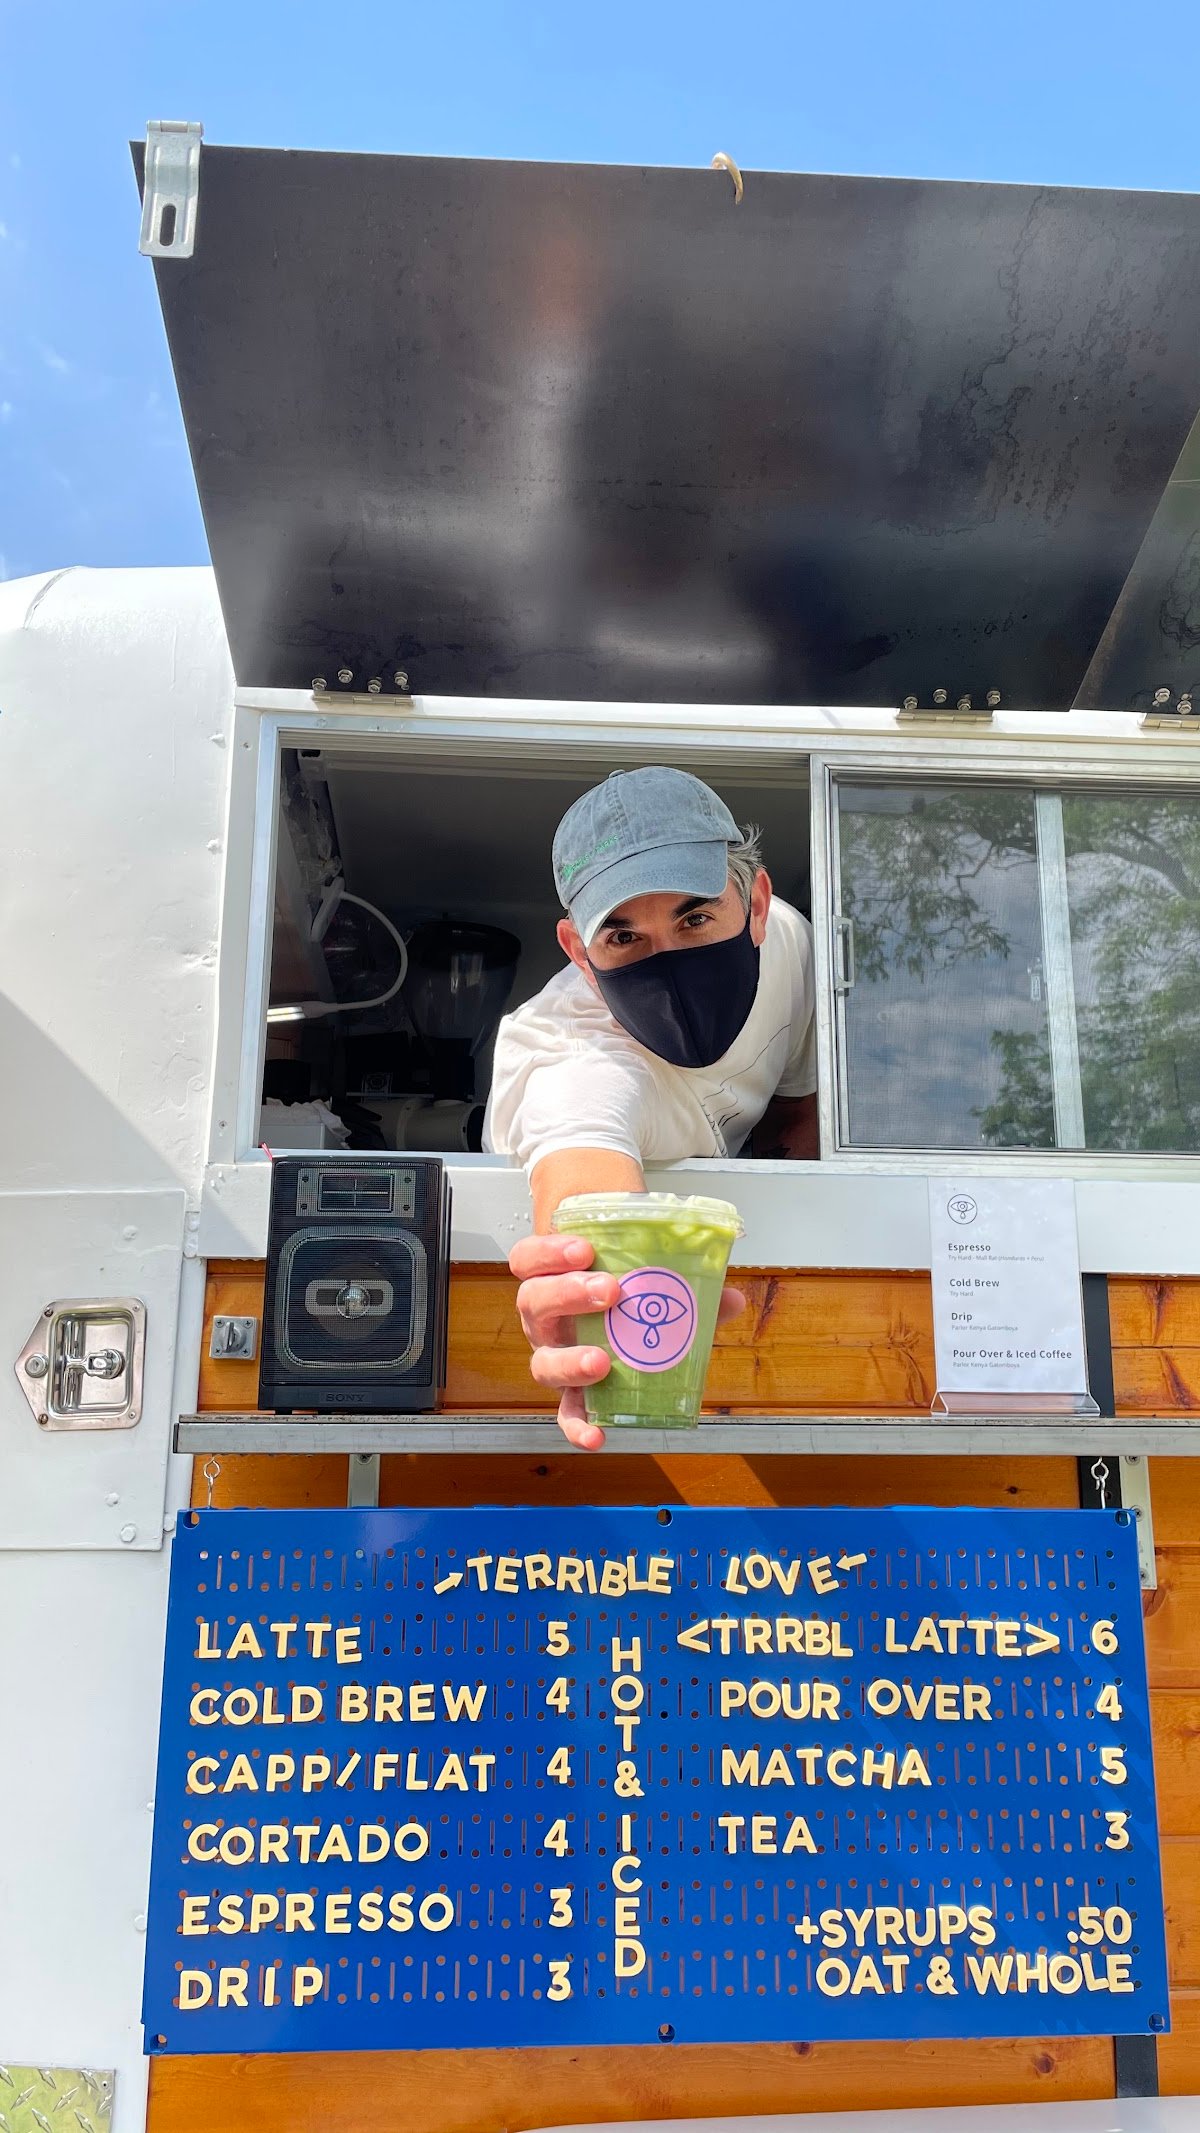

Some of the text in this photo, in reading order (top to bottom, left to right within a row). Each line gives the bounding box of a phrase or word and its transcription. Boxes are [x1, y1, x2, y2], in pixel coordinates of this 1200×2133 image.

[948, 1243, 991, 1254] Espresso
[949, 1278, 1000, 1287] Cold Brew
[951, 1312, 973, 1323] Drip
[953, 1349, 1072, 1359] Pour Over & Iced Coffee
[326, 1393, 365, 1402] SONY
[467, 1554, 839, 1598] TERRIBLE LOVE
[198, 1621, 569, 1664] LATTE 5
[1092, 1620, 1118, 1655] 6
[189, 1677, 570, 1726] COLD BREW 4
[720, 1679, 1123, 1721] POUR OVER 4
[187, 1747, 572, 1795] CAPP/FLAT 4
[721, 1747, 1128, 1789] MATCHA 5
[187, 1819, 568, 1866] CORTADO 4
[718, 1812, 1130, 1854] TEA 3
[182, 1888, 573, 1936] ESPRESSO 3
[795, 1905, 1132, 1948] +SYRUPS .50
[178, 1961, 571, 2011] DRIP 3
[816, 1953, 1134, 1996] OAT & WHOLE
